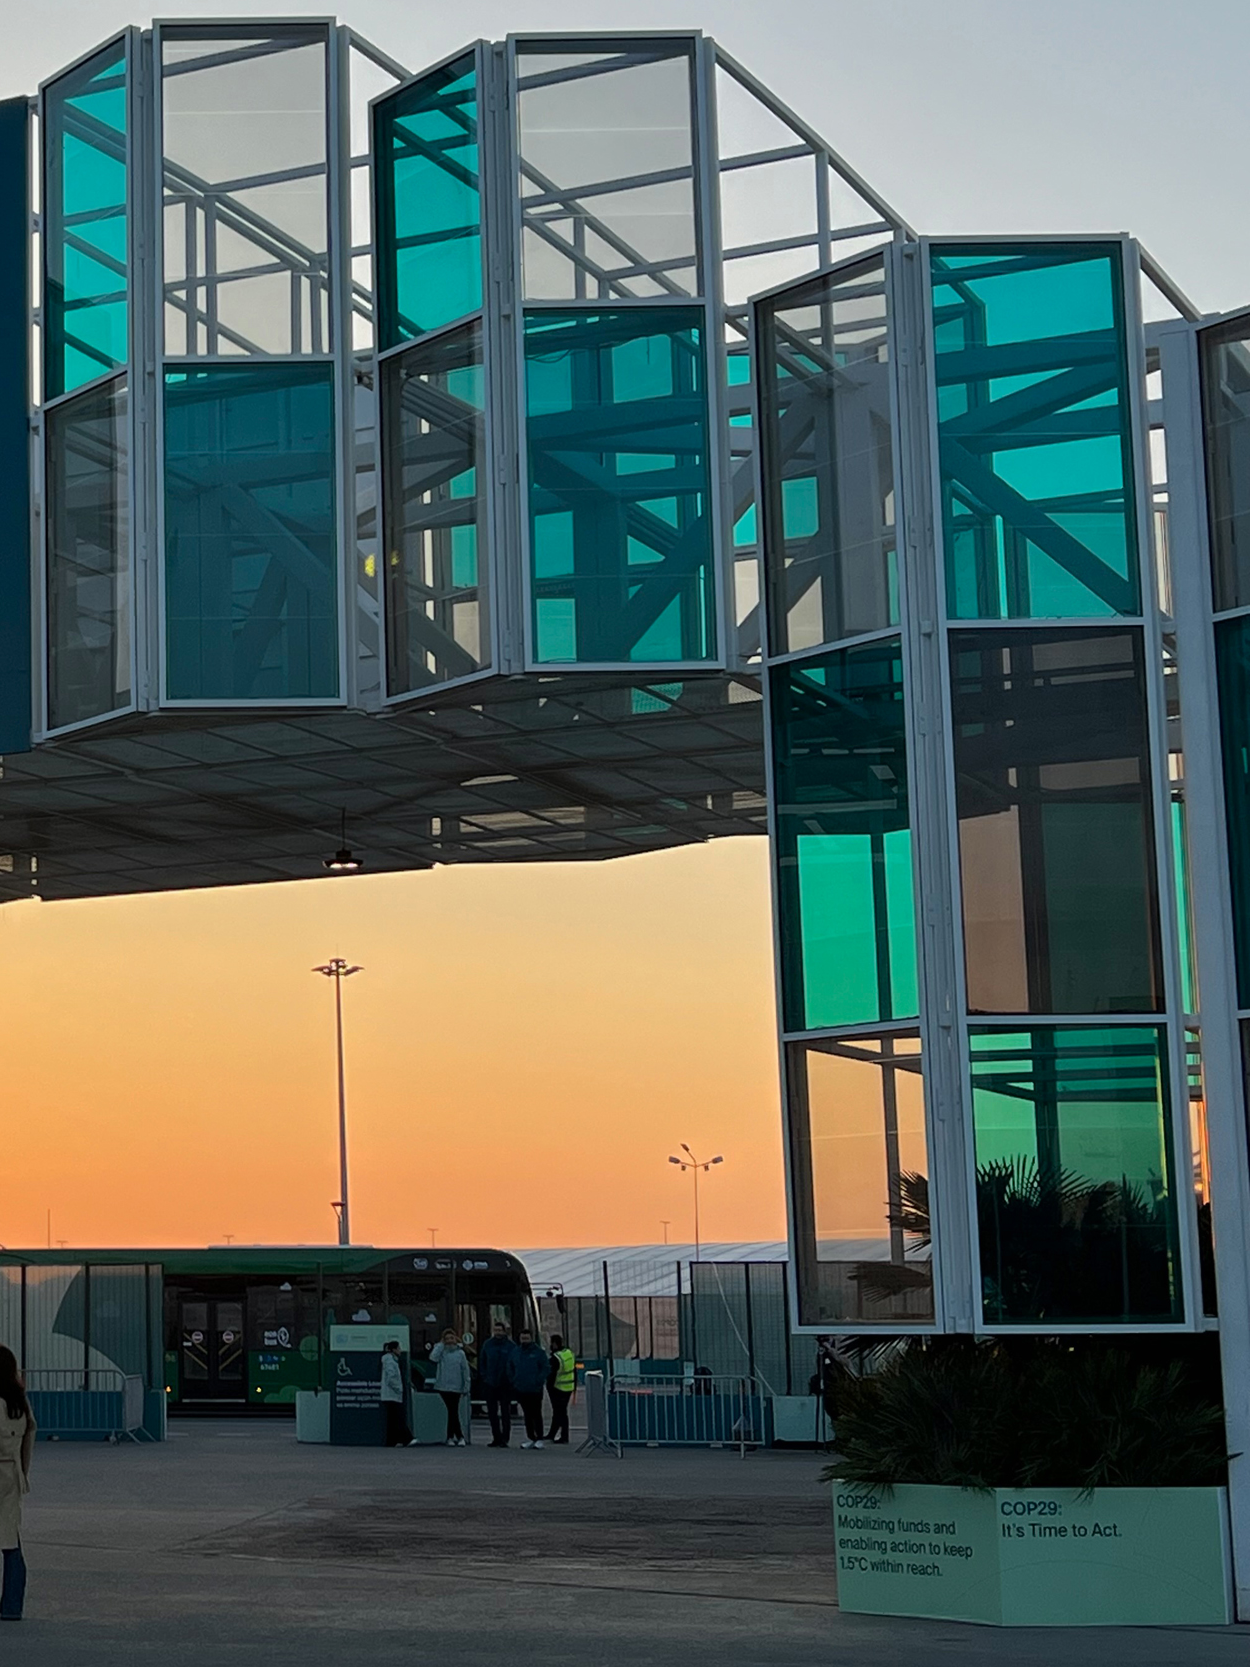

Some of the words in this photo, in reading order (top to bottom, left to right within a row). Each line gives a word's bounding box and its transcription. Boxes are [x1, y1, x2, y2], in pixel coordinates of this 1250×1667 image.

[836, 1494, 882, 1510] COP29:
[1000, 1501, 1062, 1516] COP29:
[837, 1514, 895, 1534] Mobilizing
[897, 1517, 931, 1534] funds
[933, 1520, 956, 1535] and
[1028, 1523, 1068, 1537] Time
[1071, 1523, 1088, 1537] to
[1091, 1522, 1123, 1537] Act.
[839, 1537, 887, 1554] enabling
[890, 1540, 927, 1554] action
[929, 1542, 941, 1556] to
[943, 1541, 973, 1560] keep
[869, 1558, 904, 1574] within
[906, 1562, 943, 1576] reach.
